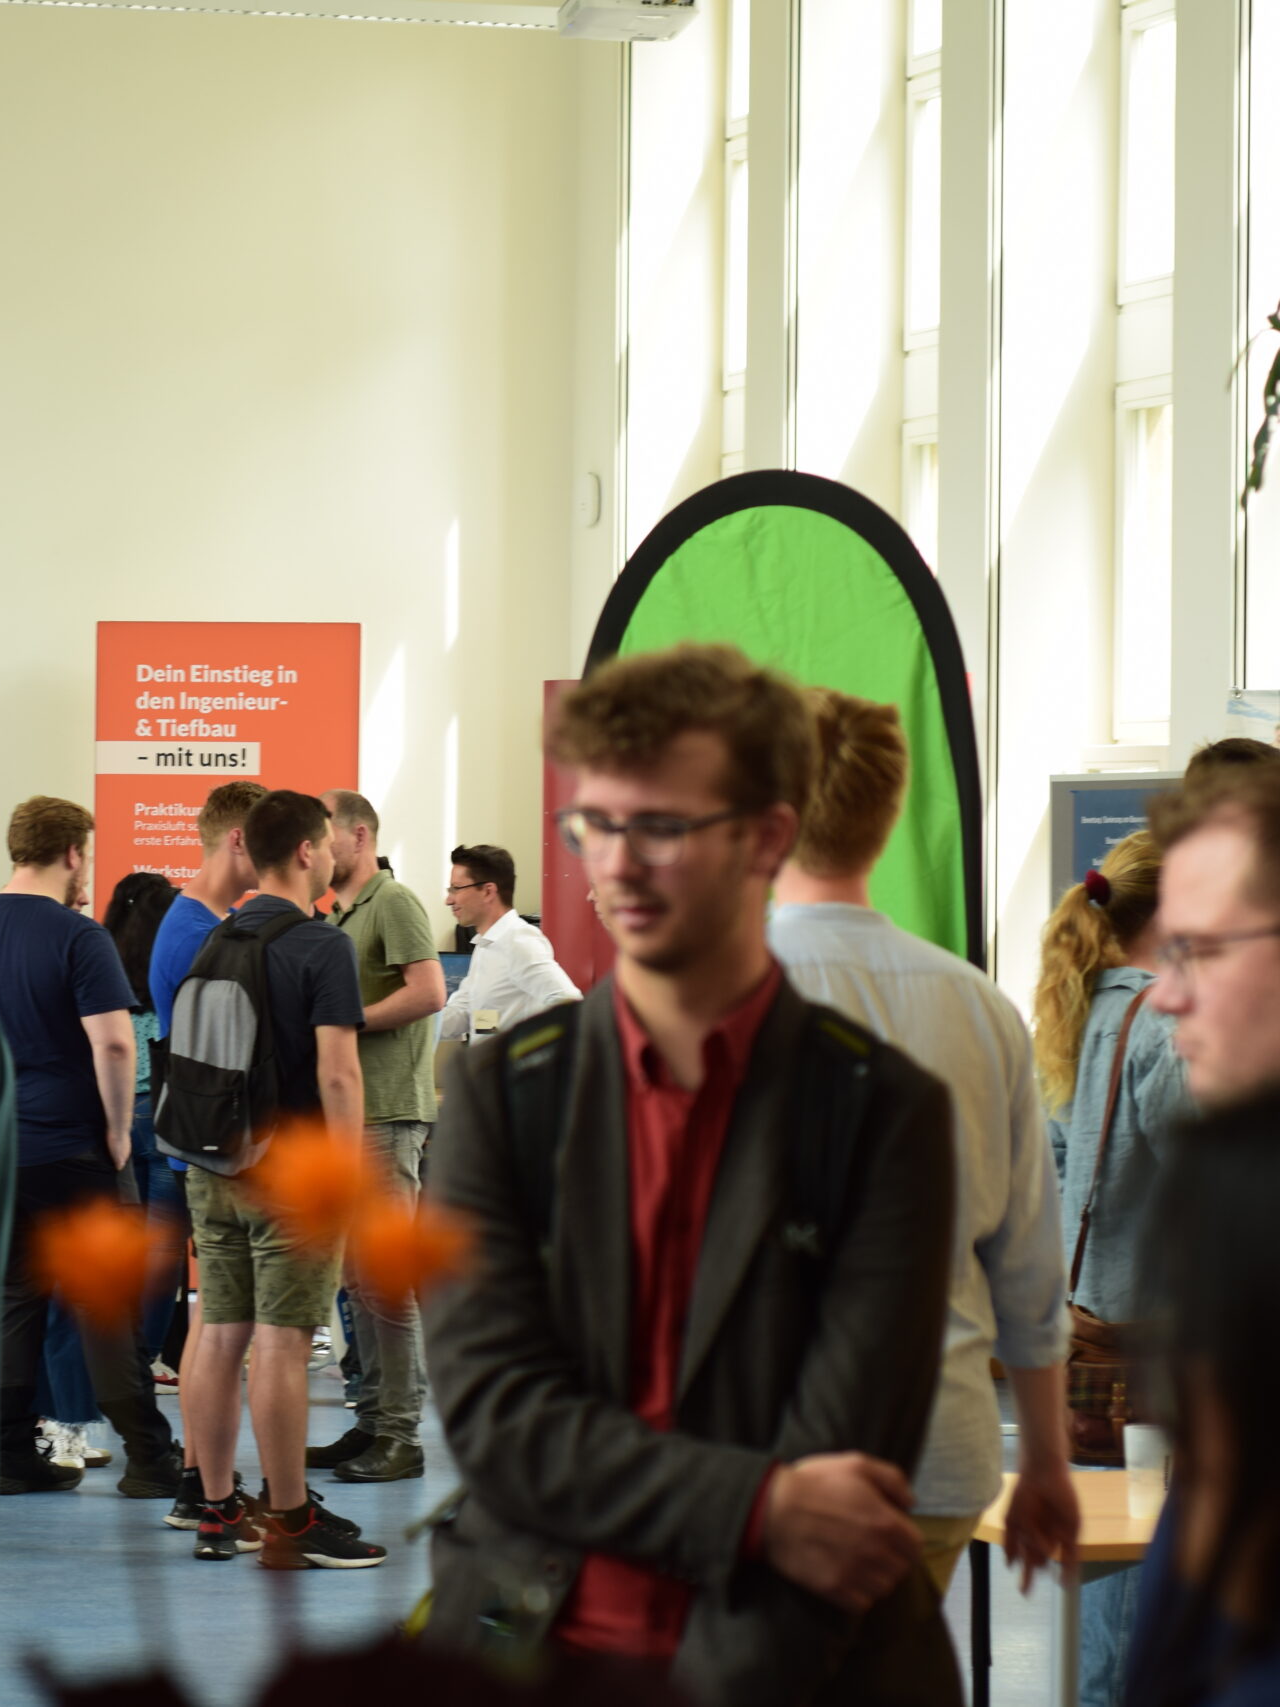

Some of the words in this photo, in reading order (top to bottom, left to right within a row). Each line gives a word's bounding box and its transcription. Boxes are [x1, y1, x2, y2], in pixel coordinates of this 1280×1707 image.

[136, 664, 185, 683] Dein
[190, 665, 273, 687] Einstieg
[277, 665, 298, 683] in
[135, 691, 175, 710] den
[180, 692, 288, 714] Ingenieur-
[135, 718, 152, 737] &
[156, 718, 237, 737] Tiefbau
[156, 748, 193, 767] mit
[200, 748, 247, 767] uns!
[134, 820, 185, 831] Praxisluft
[133, 837, 160, 846] erste
